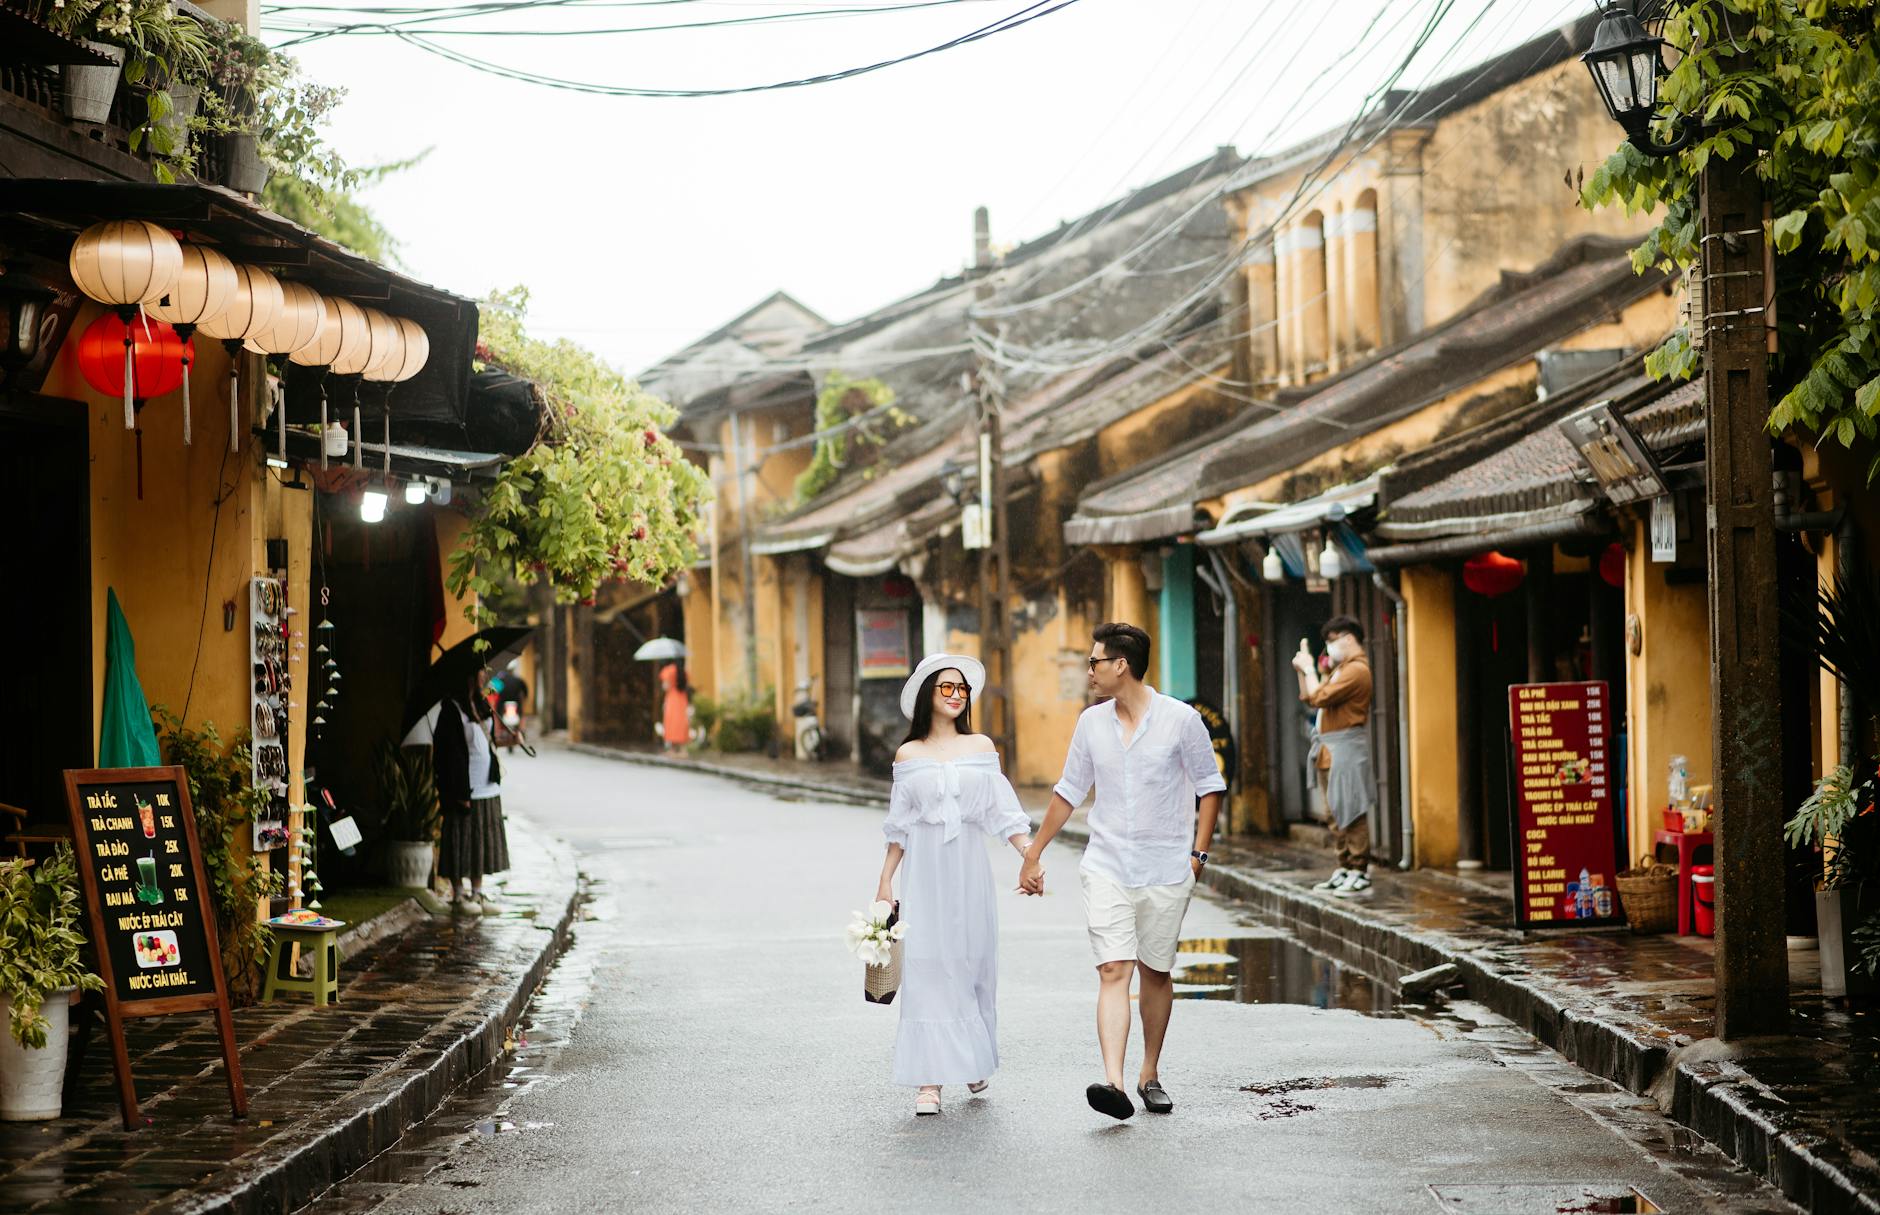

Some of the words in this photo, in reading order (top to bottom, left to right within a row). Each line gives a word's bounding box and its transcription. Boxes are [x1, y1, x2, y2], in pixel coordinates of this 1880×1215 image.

[87, 793, 102, 808] TRÀ
[101, 791, 117, 808] TẮC
[156, 794, 170, 806] 10K
[91, 815, 106, 831] TRÀ
[106, 817, 133, 830] CHANH
[160, 816, 174, 828] 15K
[1526, 829, 1546, 839] COCA
[96, 840, 111, 856] TRÀ
[111, 839, 129, 856] ĐÀO
[165, 840, 179, 853] 25K
[1527, 843, 1542, 853] 7UP
[102, 864, 114, 881] CÀ
[114, 864, 128, 880] PHÊ
[170, 864, 184, 877] 20K
[1528, 870, 1541, 880] BIA
[1542, 869, 1566, 879] LARUE
[1529, 884, 1541, 894] BIA
[1543, 883, 1564, 893] TIGER
[106, 893, 121, 906] RAU
[122, 888, 135, 905] MÁ
[174, 888, 188, 901] 15K
[1529, 897, 1554, 907] WATER
[119, 913, 142, 930] NƯỚC
[142, 912, 150, 928] ÉP
[151, 911, 167, 927] TRÁI
[168, 911, 183, 926] CÂY
[1530, 910, 1552, 920] FANTA
[129, 971, 152, 989] NƯỚC
[153, 970, 169, 987] GIẢI
[170, 969, 187, 985] KHÁT
